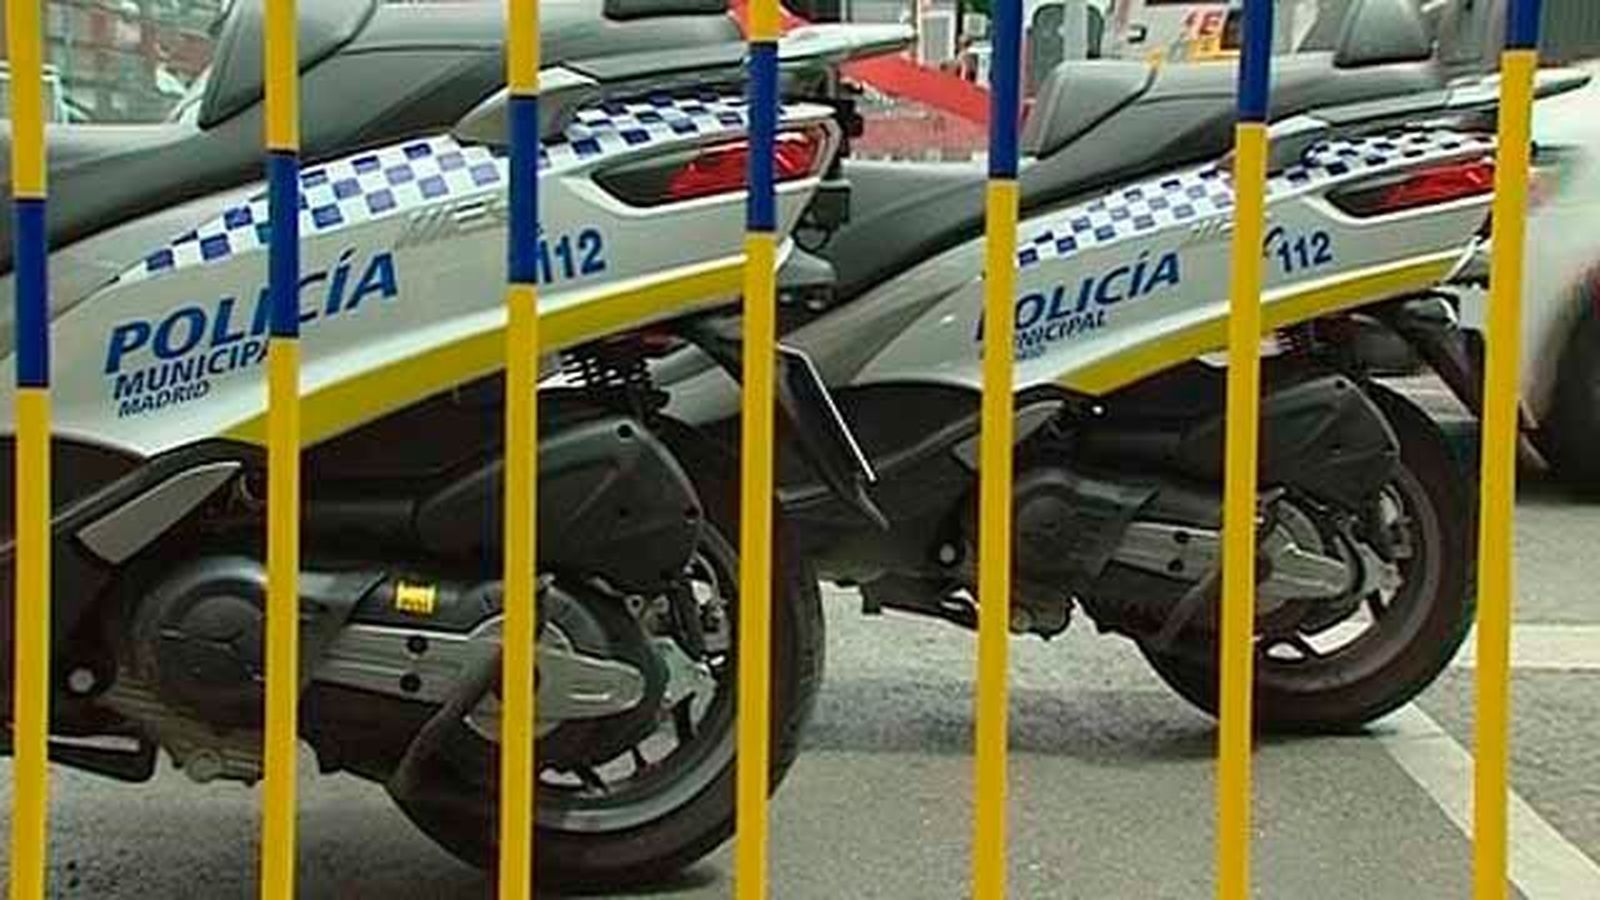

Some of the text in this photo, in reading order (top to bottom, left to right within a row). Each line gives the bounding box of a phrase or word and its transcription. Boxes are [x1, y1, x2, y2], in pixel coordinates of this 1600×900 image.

[537, 227, 607, 285] 112
[1277, 230, 1333, 273] 112
[976, 250, 1182, 341] OLICÍA
[114, 339, 269, 400] MUNICIP
[118, 379, 211, 419] MADRID
